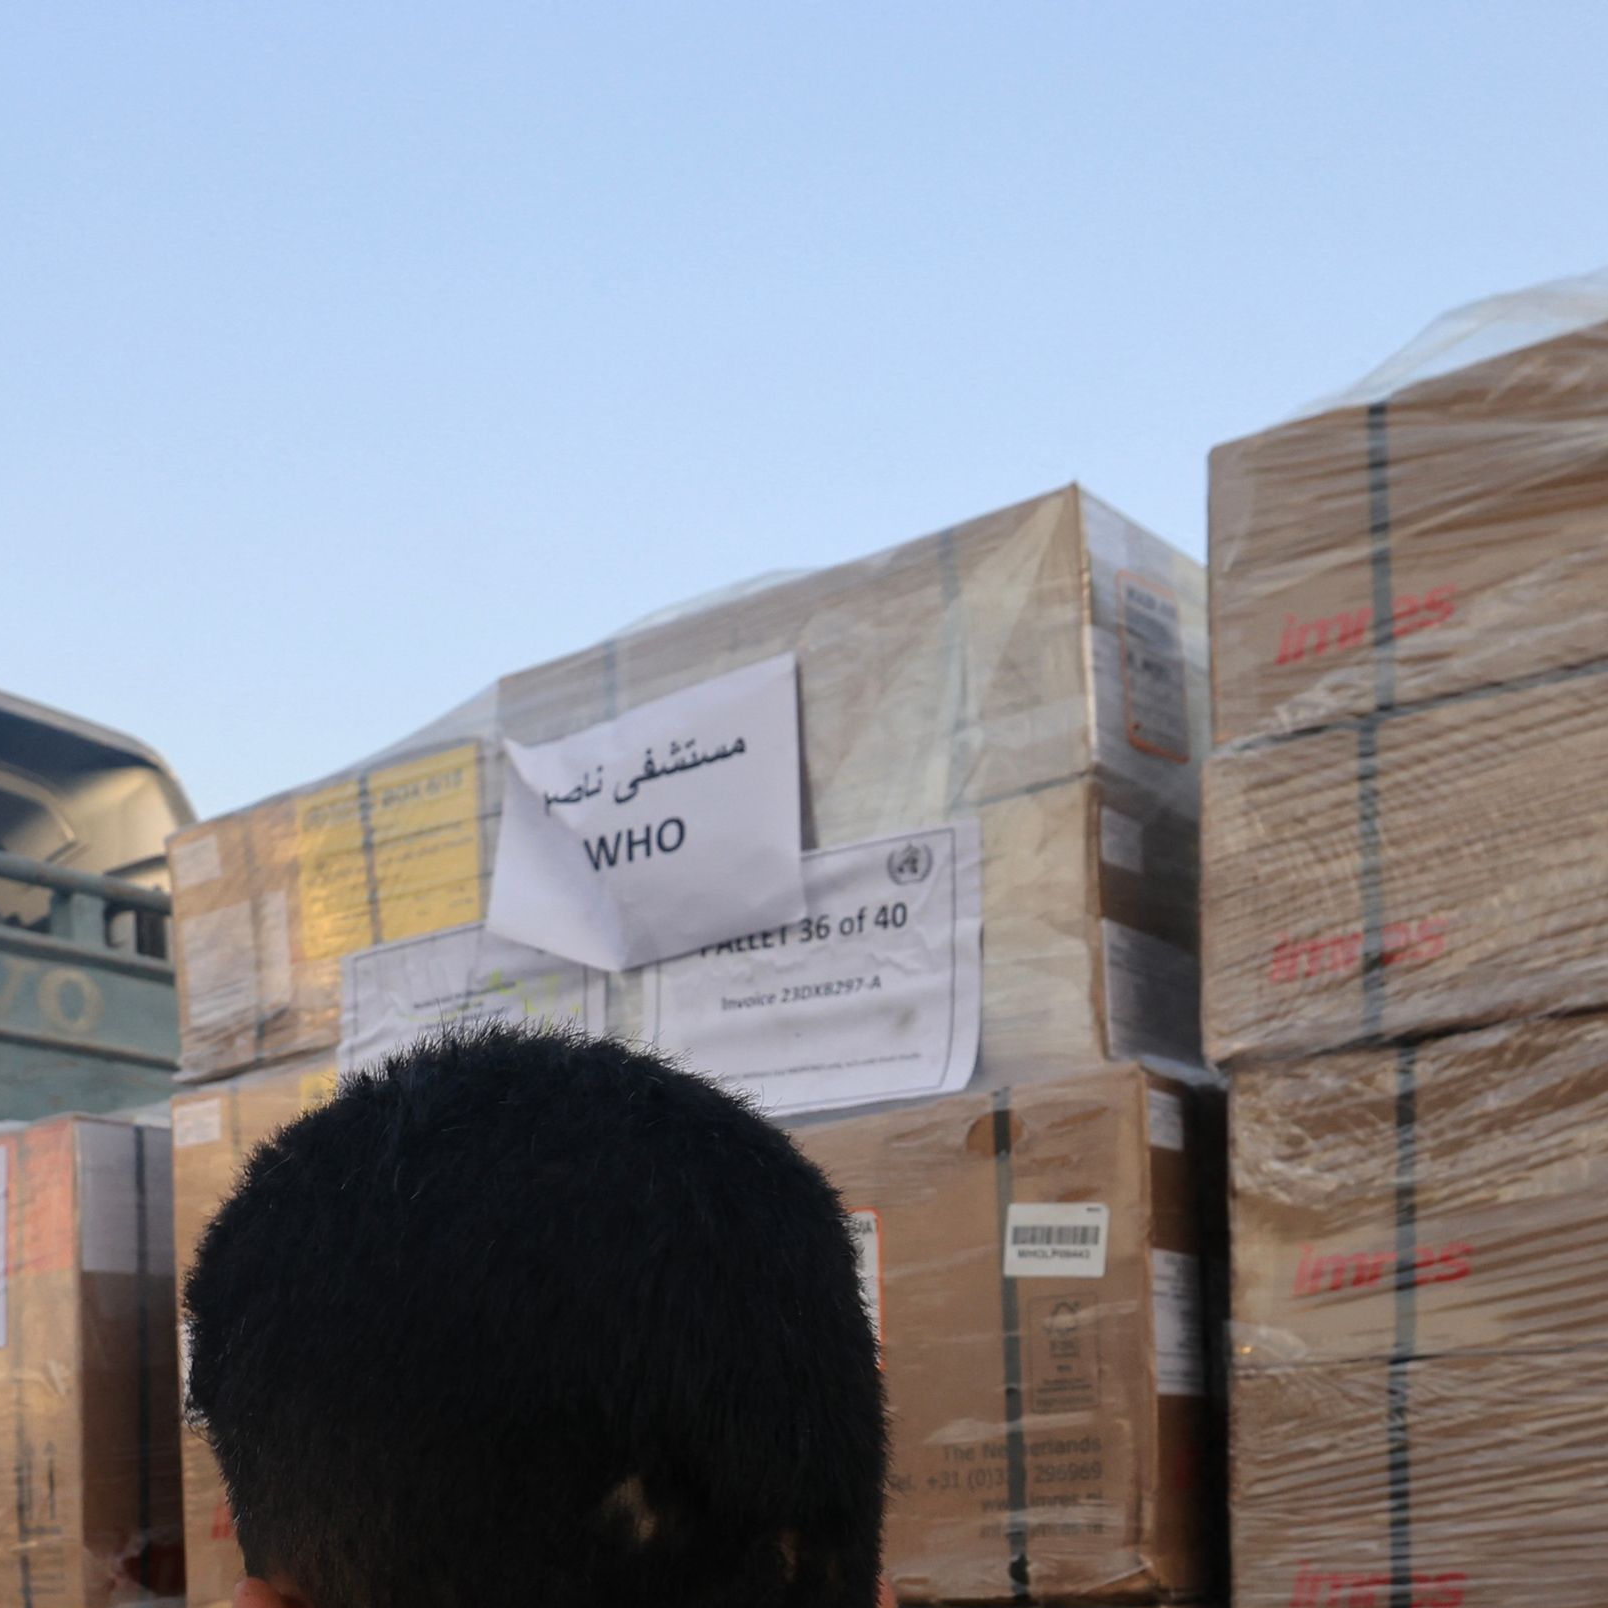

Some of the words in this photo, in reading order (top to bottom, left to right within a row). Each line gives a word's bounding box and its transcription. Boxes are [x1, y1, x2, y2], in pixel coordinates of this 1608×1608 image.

[614, 737, 746, 804] مستشفى
[584, 817, 686, 872] WHO
[798, 915, 831, 943] 36
[839, 906, 868, 936] of
[874, 902, 908, 930] 40
[721, 989, 777, 1011] Invoice
